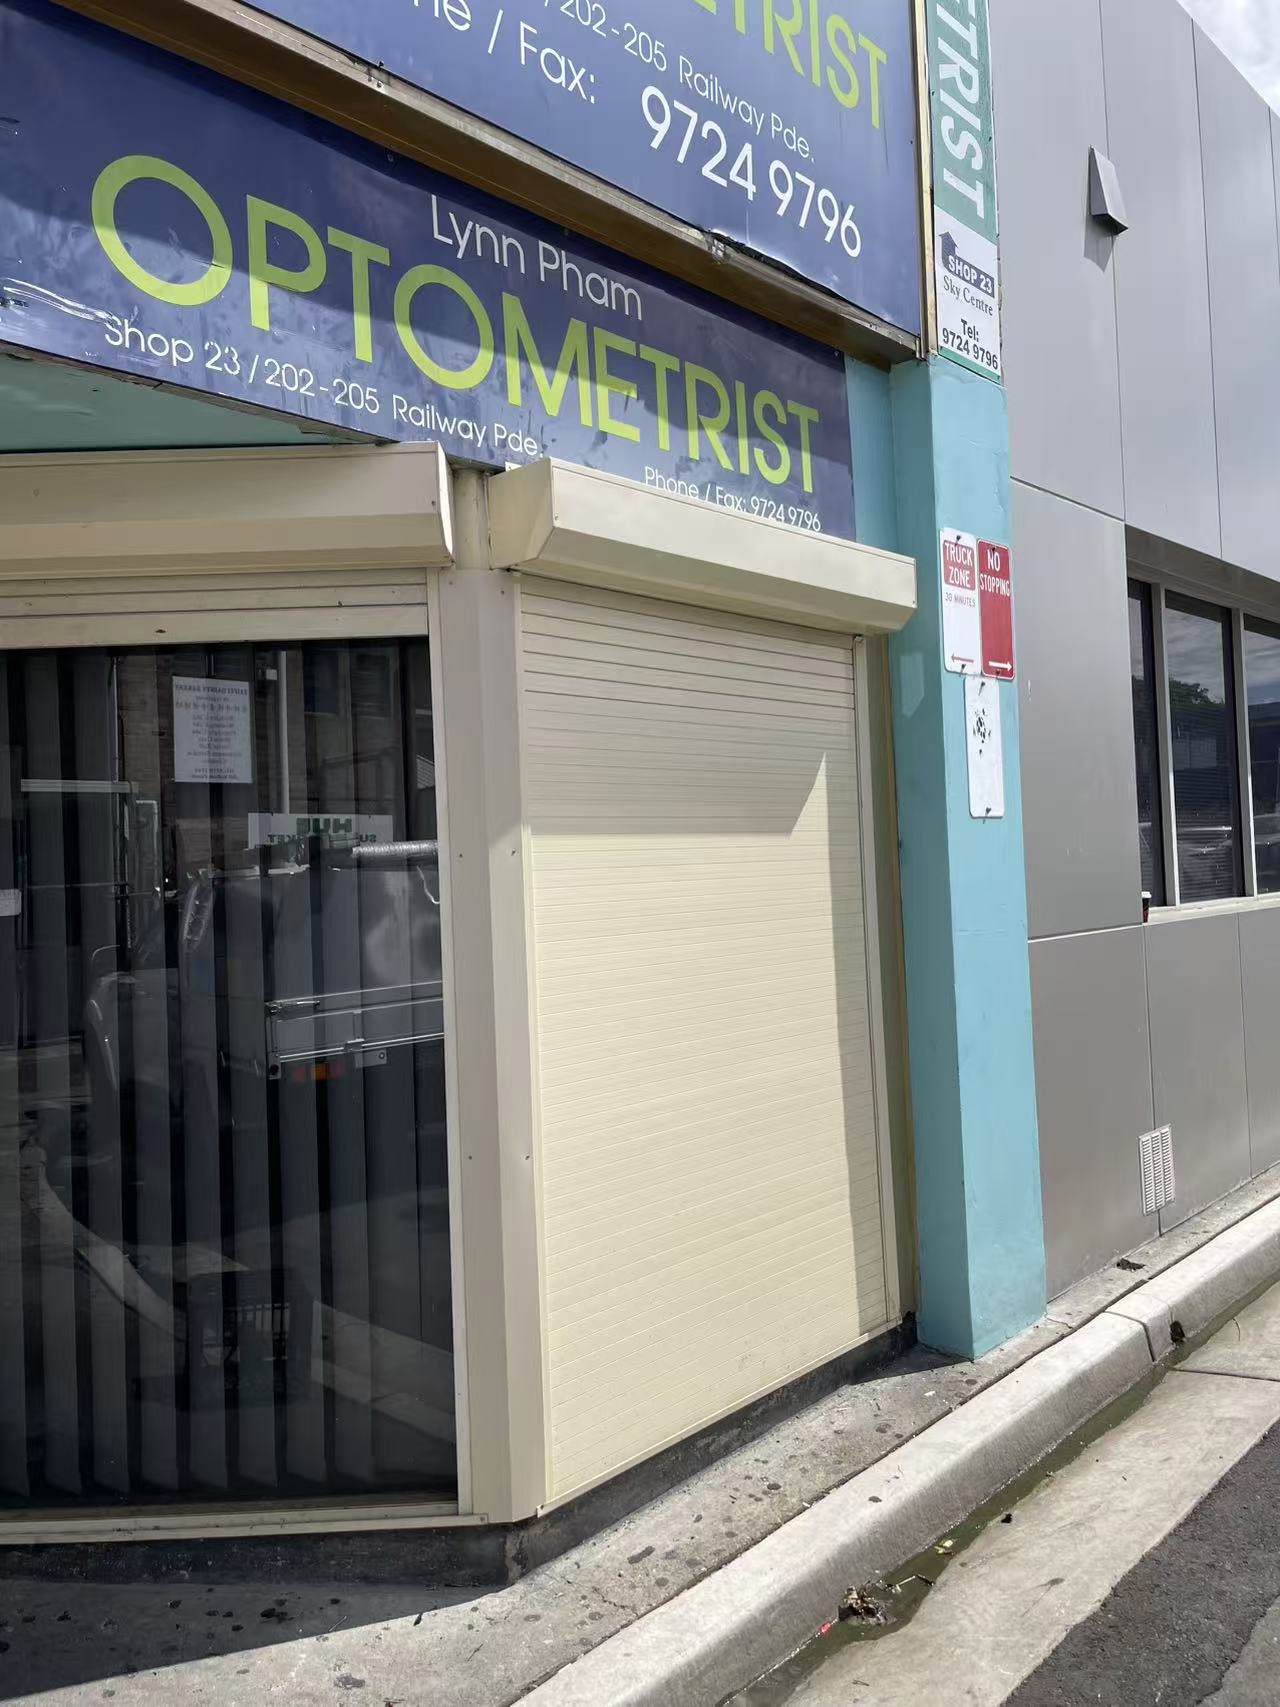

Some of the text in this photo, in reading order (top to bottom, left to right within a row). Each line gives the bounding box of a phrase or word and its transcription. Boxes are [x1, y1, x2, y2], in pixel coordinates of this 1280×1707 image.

[679, 55, 766, 135] Railway
[771, 113, 815, 163] Pde.
[487, 9, 504, 54] /
[519, 21, 596, 104] Fax:
[640, 86, 757, 201] 9724
[768, 160, 862, 258] 9796
[431, 194, 642, 320] Lynn Pham
[948, 255, 993, 295] SHOP 23
[943, 275, 994, 317] Sky Centre
[91, 154, 820, 494] OPTOMETRIST
[960, 318, 980, 343] Tel:
[942, 327, 998, 370] 9724 9796
[103, 316, 194, 366] Shop
[204, 341, 241, 376] 23
[248, 355, 260, 384] /
[264, 358, 380, 415] 202-205
[392, 393, 489, 447] Railway
[645, 465, 822, 533] Phone / Fax: 9724 9796
[945, 542, 974, 567] TRUCK
[987, 549, 1001, 573] NO
[949, 566, 971, 588] ZONE
[979, 573, 1011, 597] STOPPING
